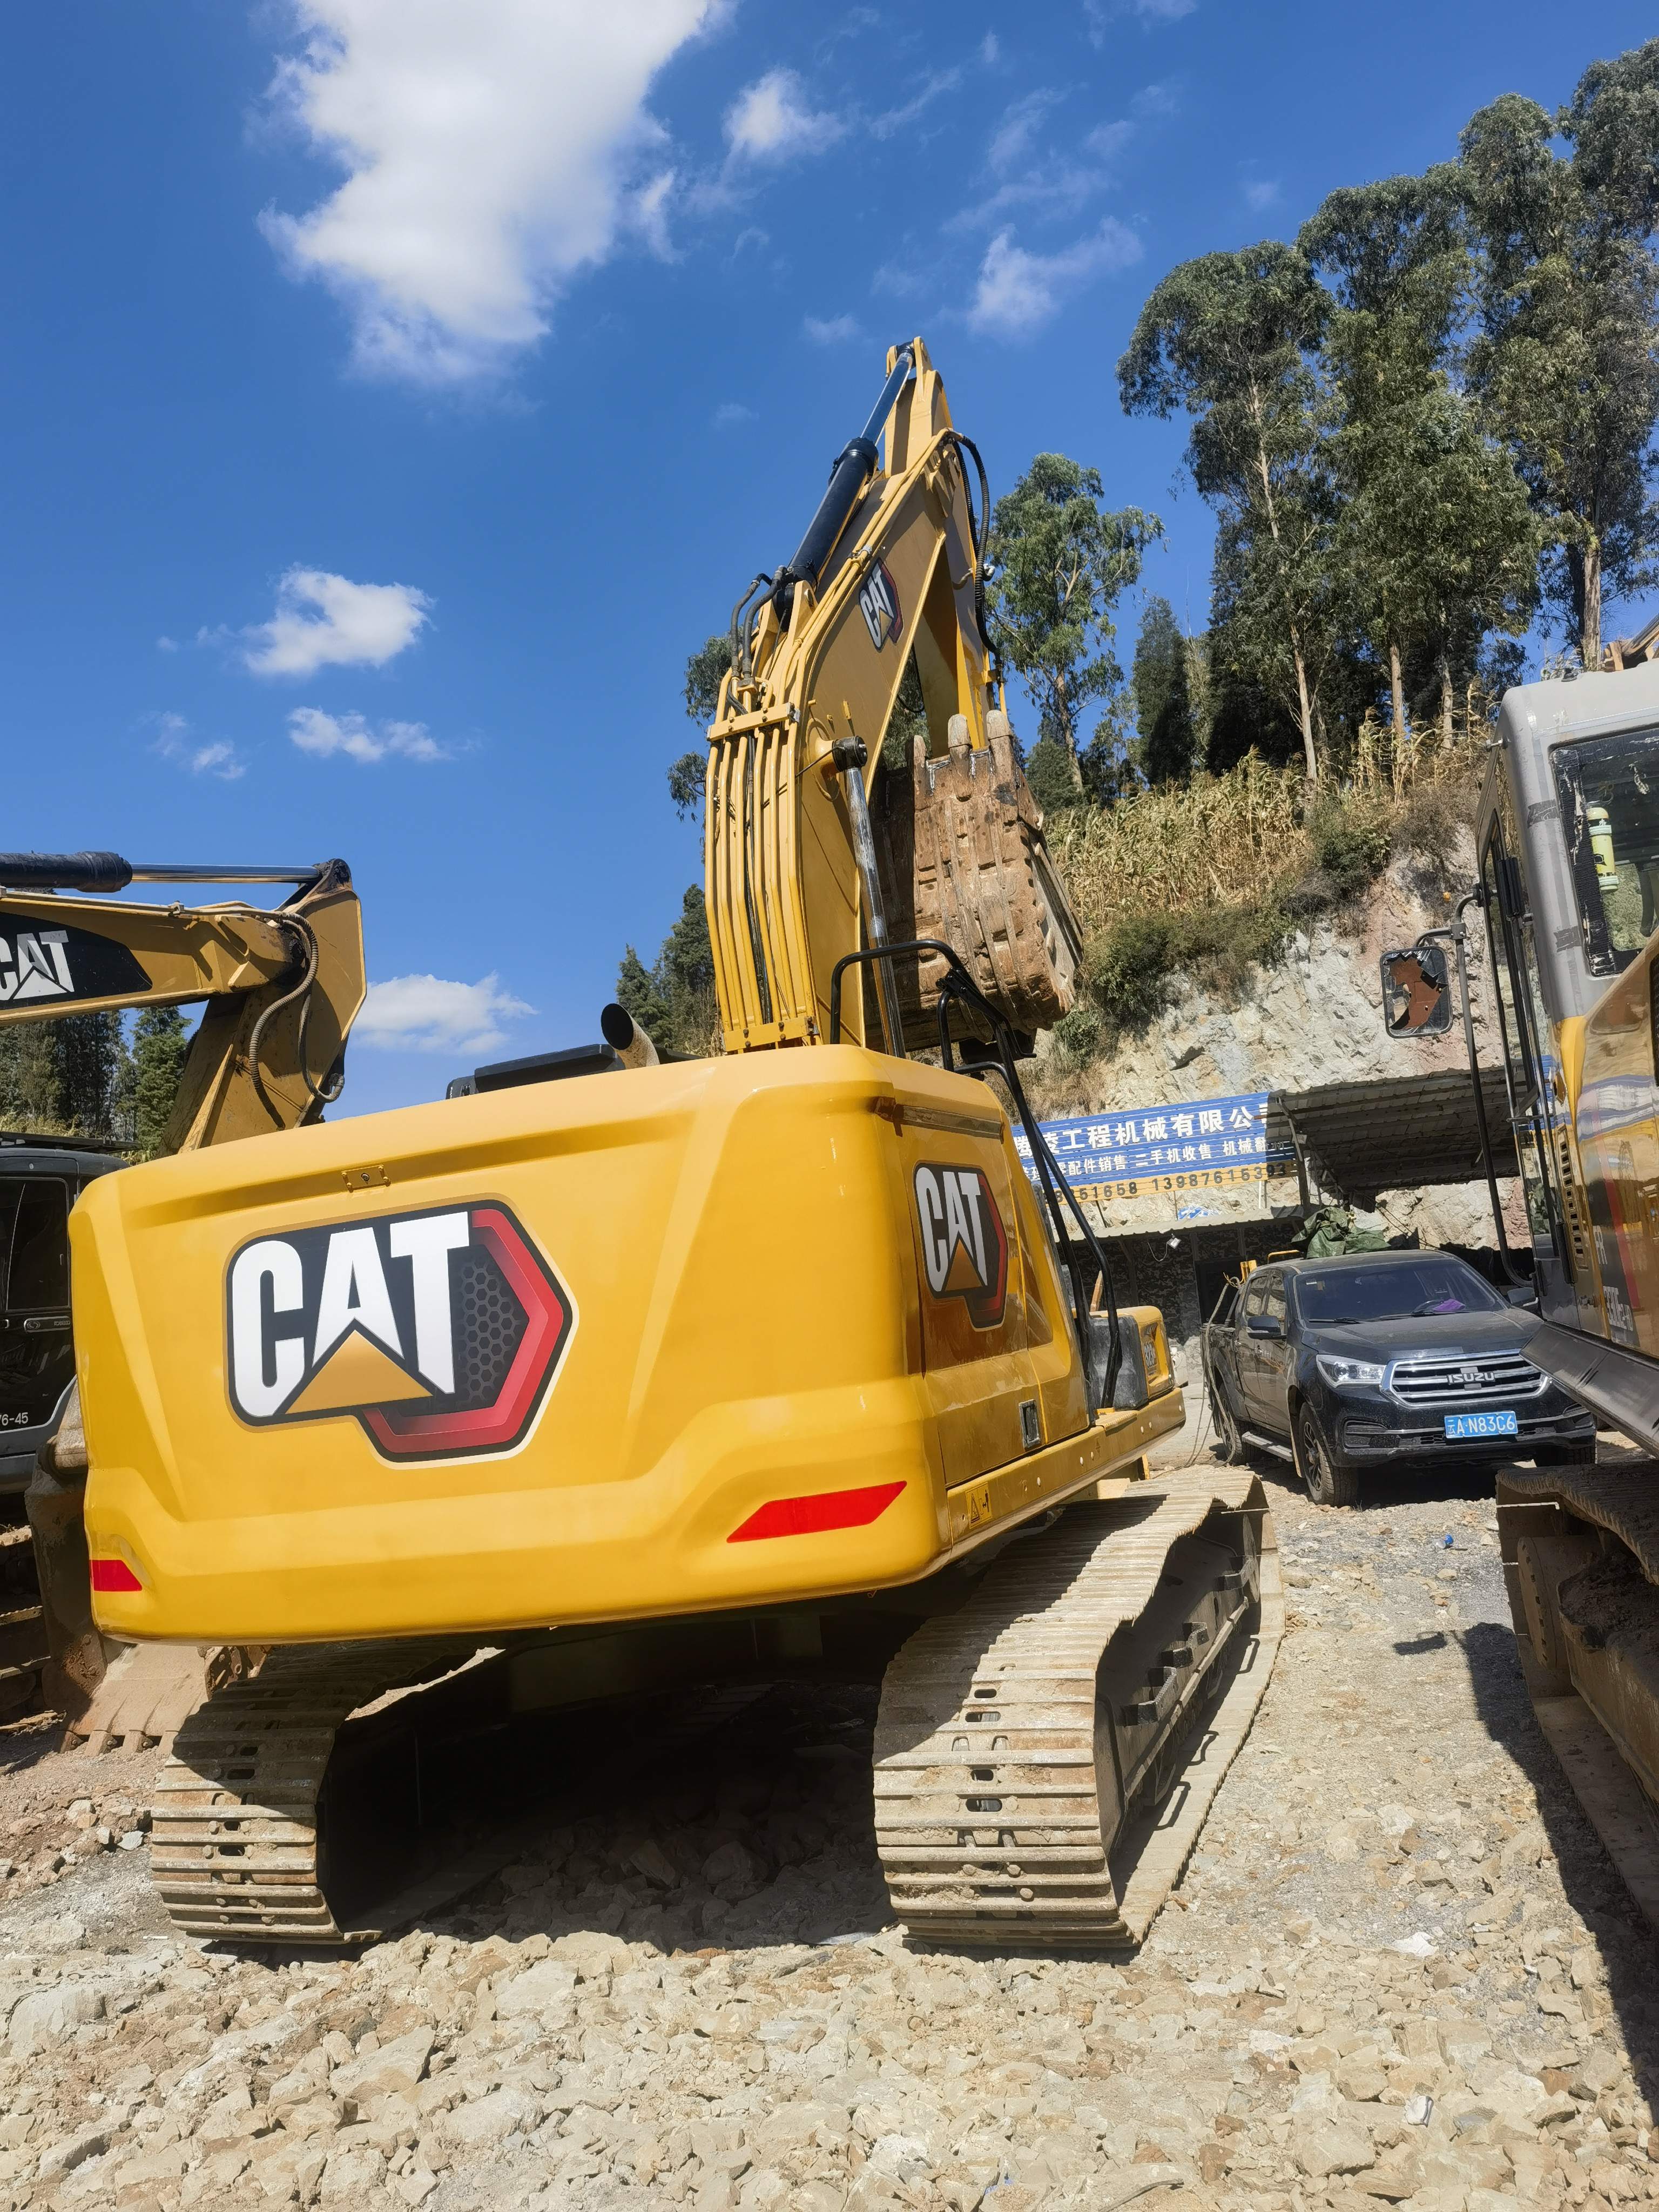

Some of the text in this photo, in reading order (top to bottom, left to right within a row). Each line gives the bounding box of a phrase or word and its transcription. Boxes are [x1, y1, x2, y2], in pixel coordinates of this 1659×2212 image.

[860, 563, 894, 648] CAT
[1135, 1143, 1212, 1166] 二手机收售
[1152, 1162, 1286, 1191] 13987615393
[916, 1167, 988, 1292] CAT
[232, 1211, 469, 1417] CAT
[1448, 1372, 1495, 1384] ISUZU
[0, 1412, 29, 1426] 6-45
